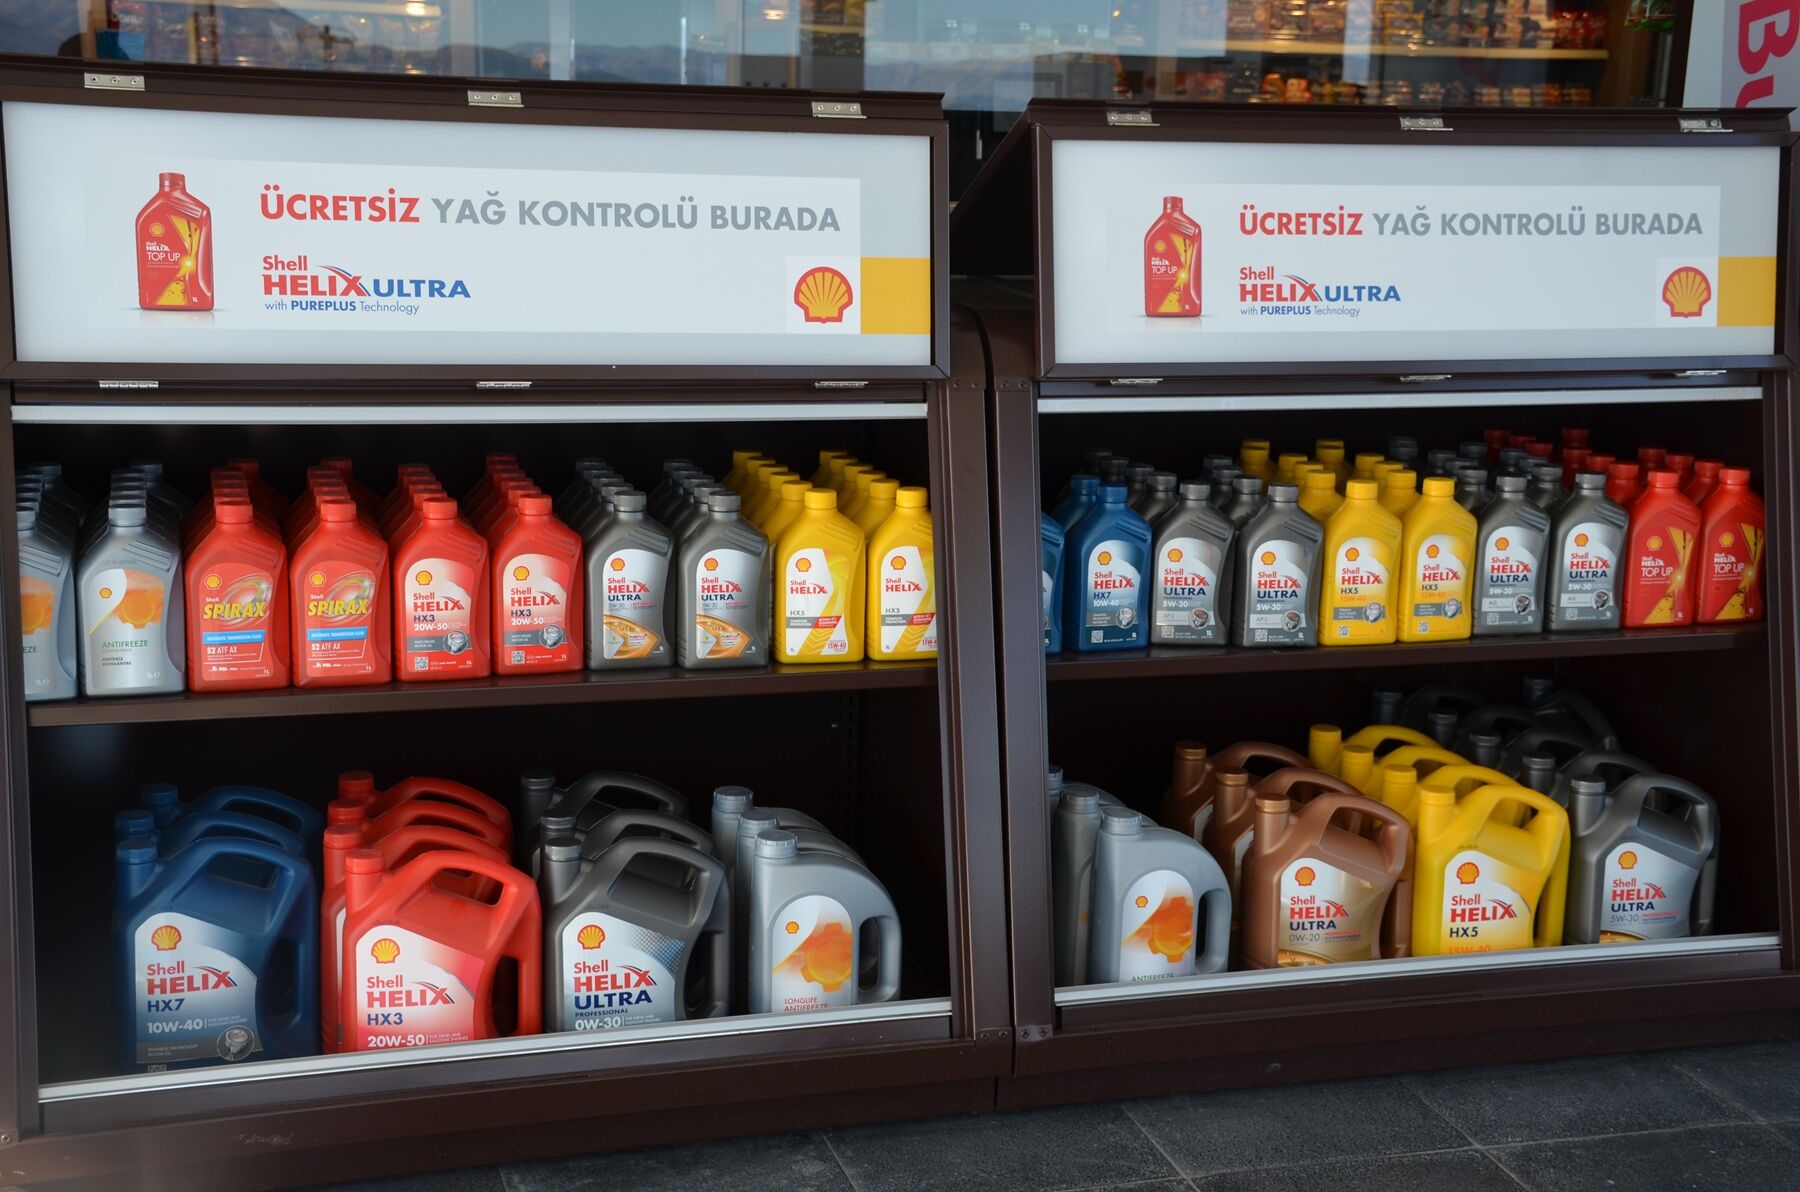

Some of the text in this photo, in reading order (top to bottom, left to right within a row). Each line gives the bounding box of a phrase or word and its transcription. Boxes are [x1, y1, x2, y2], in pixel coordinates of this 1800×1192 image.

[261, 184, 840, 231] ÜCRETSİZ YAĞ KONTROLÜ BURADA
[1240, 204, 1703, 236] ÜCRETSİZ YAĞ KONTROLÜ BURADA
[147, 252, 180, 261] TOP UP
[263, 255, 307, 271] Shell
[1240, 266, 1274, 280] Shell
[262, 269, 471, 298] HELIX ULTRA
[1239, 278, 1400, 302] HELIX ULTRA
[265, 300, 419, 315] with PUREPLUS Technology
[1240, 306, 1360, 318] with PUREPLUS Technology
[1491, 562, 1531, 573] HELIX
[1570, 558, 1610, 570] HELIX
[1714, 563, 1744, 573] TOP UP
[1094, 571, 1112, 579] Shell
[1423, 570, 1460, 582] HELIX
[1642, 567, 1673, 577] TOP UP
[1094, 578, 1134, 590] HELIX
[1164, 575, 1209, 586] HELIX
[1257, 578, 1301, 589] HELIX
[1342, 574, 1382, 585] HELIX
[1490, 575, 1529, 583] ULTRA
[511, 587, 531, 595] Shell
[608, 582, 649, 593] HELIX
[701, 582, 742, 593] HELIX
[791, 585, 828, 594] HELIX
[886, 583, 922, 592] HELIX
[1164, 588, 1206, 596] ULTRA
[511, 594, 560, 606] HELIX
[1257, 590, 1298, 598] ULTRA
[203, 602, 266, 620] SPIRAX
[308, 599, 369, 616] SPIRAX
[413, 598, 464, 612] HELIX
[511, 609, 532, 617] HX3
[414, 623, 448, 631] 20W-50
[511, 618, 544, 626] 20W-50
[102, 640, 148, 648] ANTIFREEZE
[1613, 878, 1636, 888] Shell
[1612, 885, 1666, 901] HELIX
[1290, 895, 1315, 905] Shell
[1452, 894, 1480, 905] Shell
[1290, 902, 1348, 919] HELIX
[1451, 902, 1517, 923] HELIX
[1611, 902, 1654, 912] ULTRA
[1610, 914, 1638, 923] 5W-30
[1290, 920, 1336, 931] ULTRA
[1289, 933, 1320, 942] 0W-20
[1450, 927, 1478, 937] HX5
[147, 961, 184, 975] Shell
[574, 960, 608, 973] Shell
[147, 969, 237, 995] HELIX
[367, 975, 403, 988] Shell
[574, 968, 657, 993] HELIX
[366, 985, 454, 1008] HELIX
[575, 990, 653, 1009] ULTRA
[148, 998, 185, 1012] HX7
[368, 1012, 403, 1025] HX3
[575, 1009, 628, 1017] PROFESSIONAL
[147, 1019, 202, 1033] 10W-40
[575, 1016, 621, 1031] 0W-30
[368, 1034, 425, 1047] 20W-50
